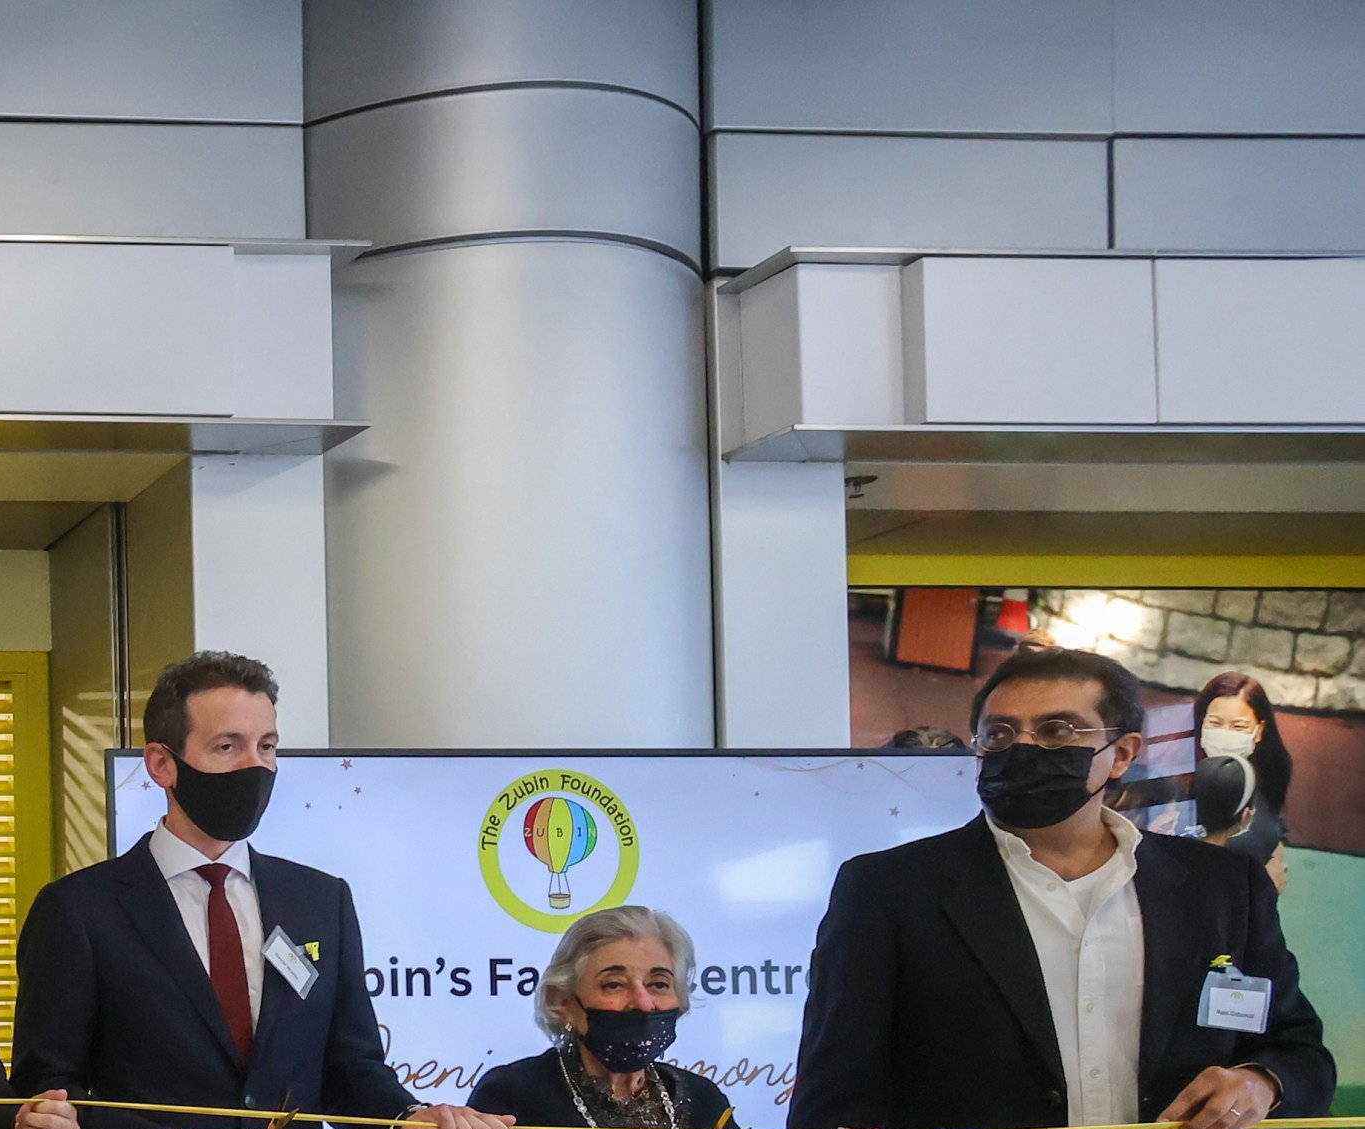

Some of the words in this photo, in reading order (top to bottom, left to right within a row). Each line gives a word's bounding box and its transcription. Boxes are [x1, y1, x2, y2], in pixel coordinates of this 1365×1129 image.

[481, 814, 502, 851] The
[498, 775, 550, 811] Zubin
[560, 774, 635, 847] Foundation
[489, 957, 540, 997] Fa
[691, 958, 811, 997] entr
